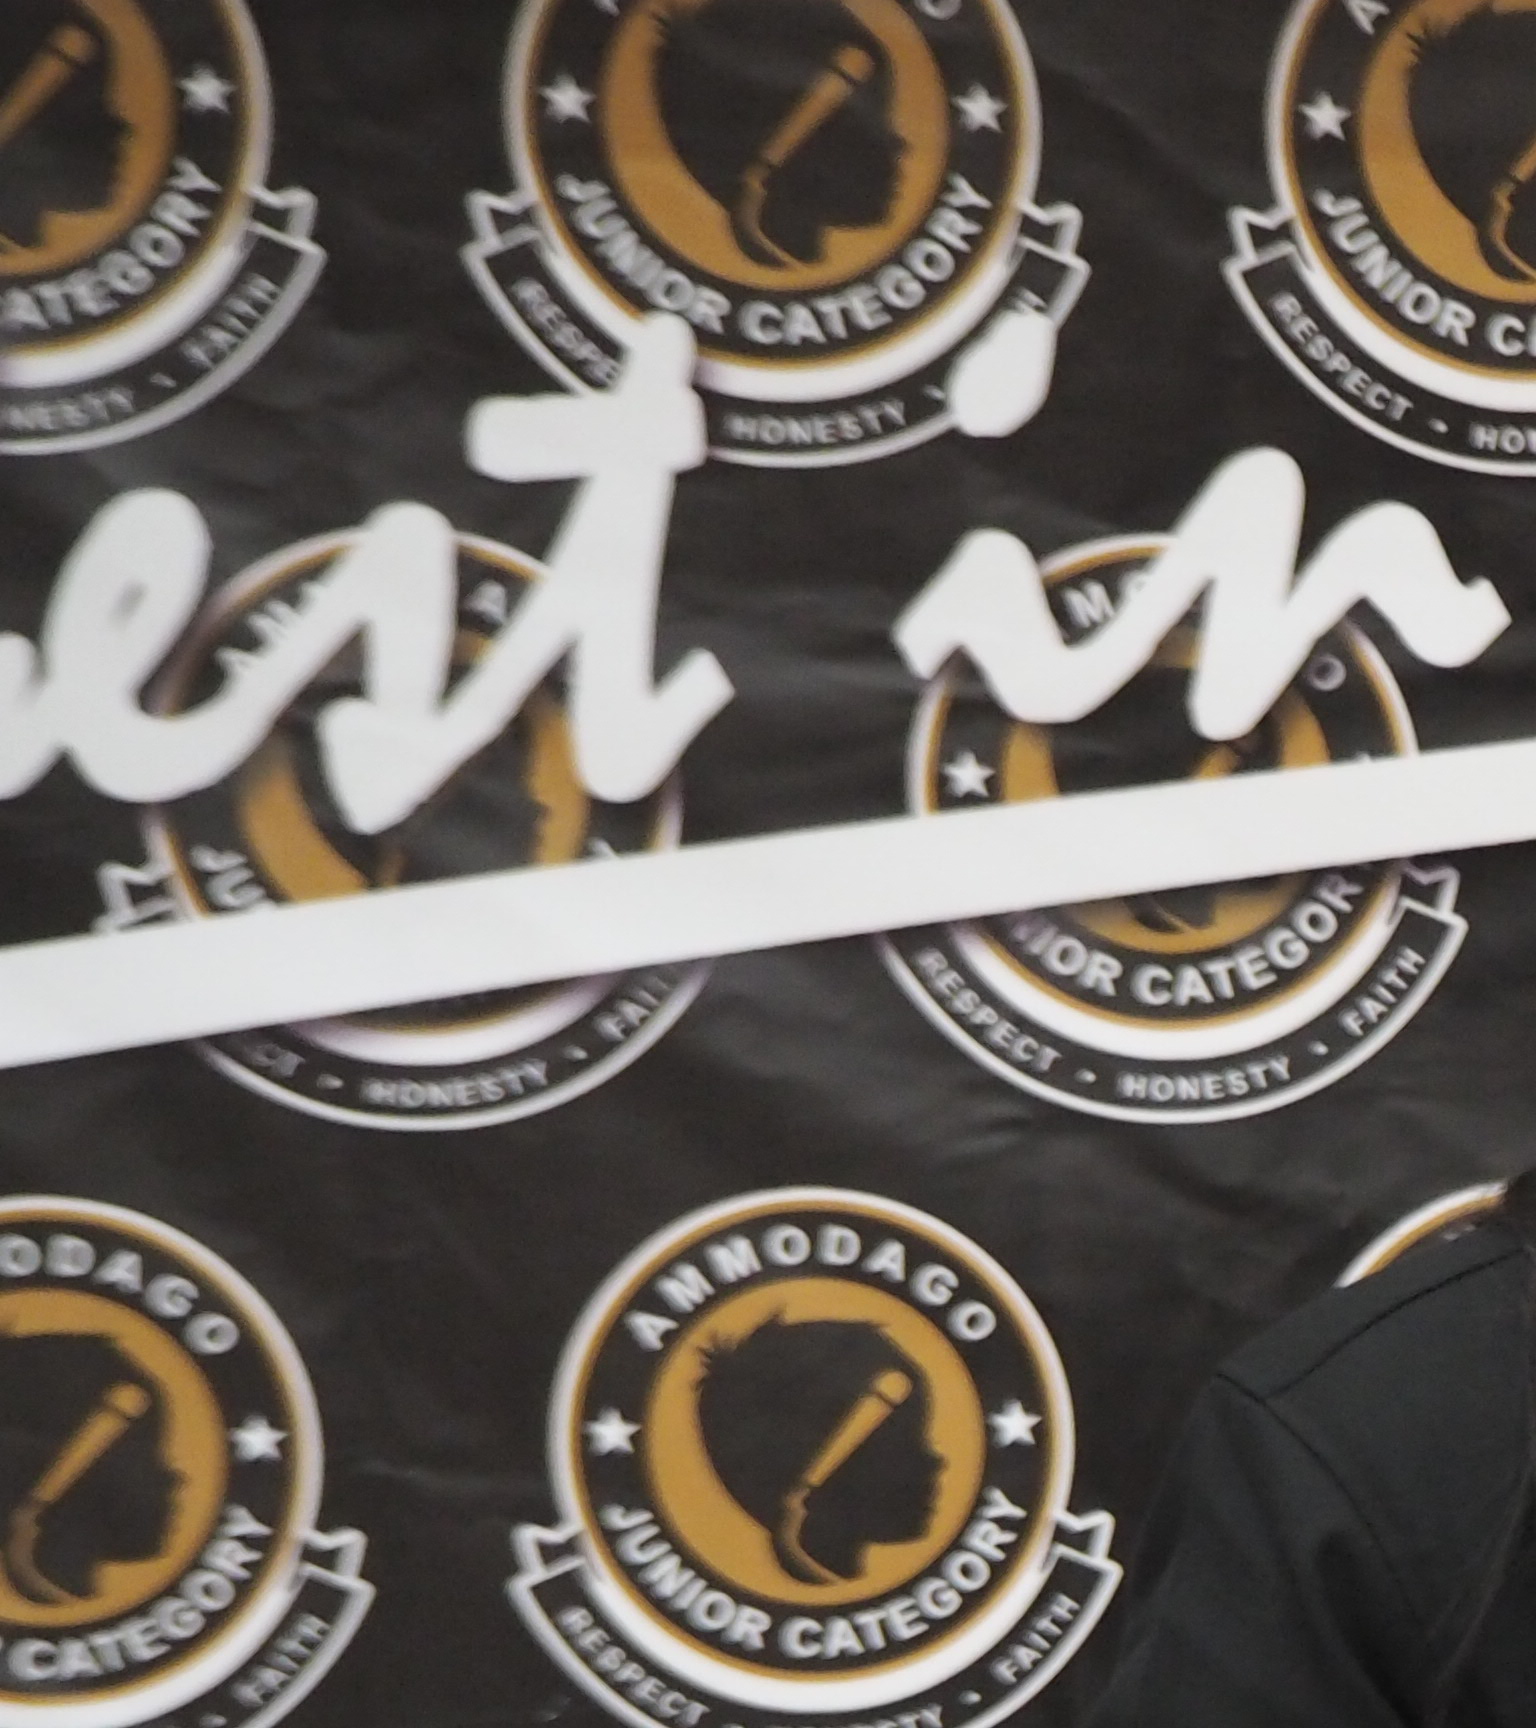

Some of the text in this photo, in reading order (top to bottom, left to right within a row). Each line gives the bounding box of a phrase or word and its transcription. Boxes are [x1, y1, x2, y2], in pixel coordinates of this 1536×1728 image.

[555, 172, 994, 348] JUNIOR CATEGORY
[1313, 188, 1477, 348] JUNIOR
[1273, 290, 1413, 422] RESPECT
[914, 946, 1427, 1102] RESPECT HONESTY FAITH
[622, 1222, 998, 1350] AMMODAGO
[8, 1503, 273, 1683] CATEGORY
[600, 1486, 1030, 1662] JUNIOR CATEGORY
[988, 1593, 1082, 1688] FAITH
